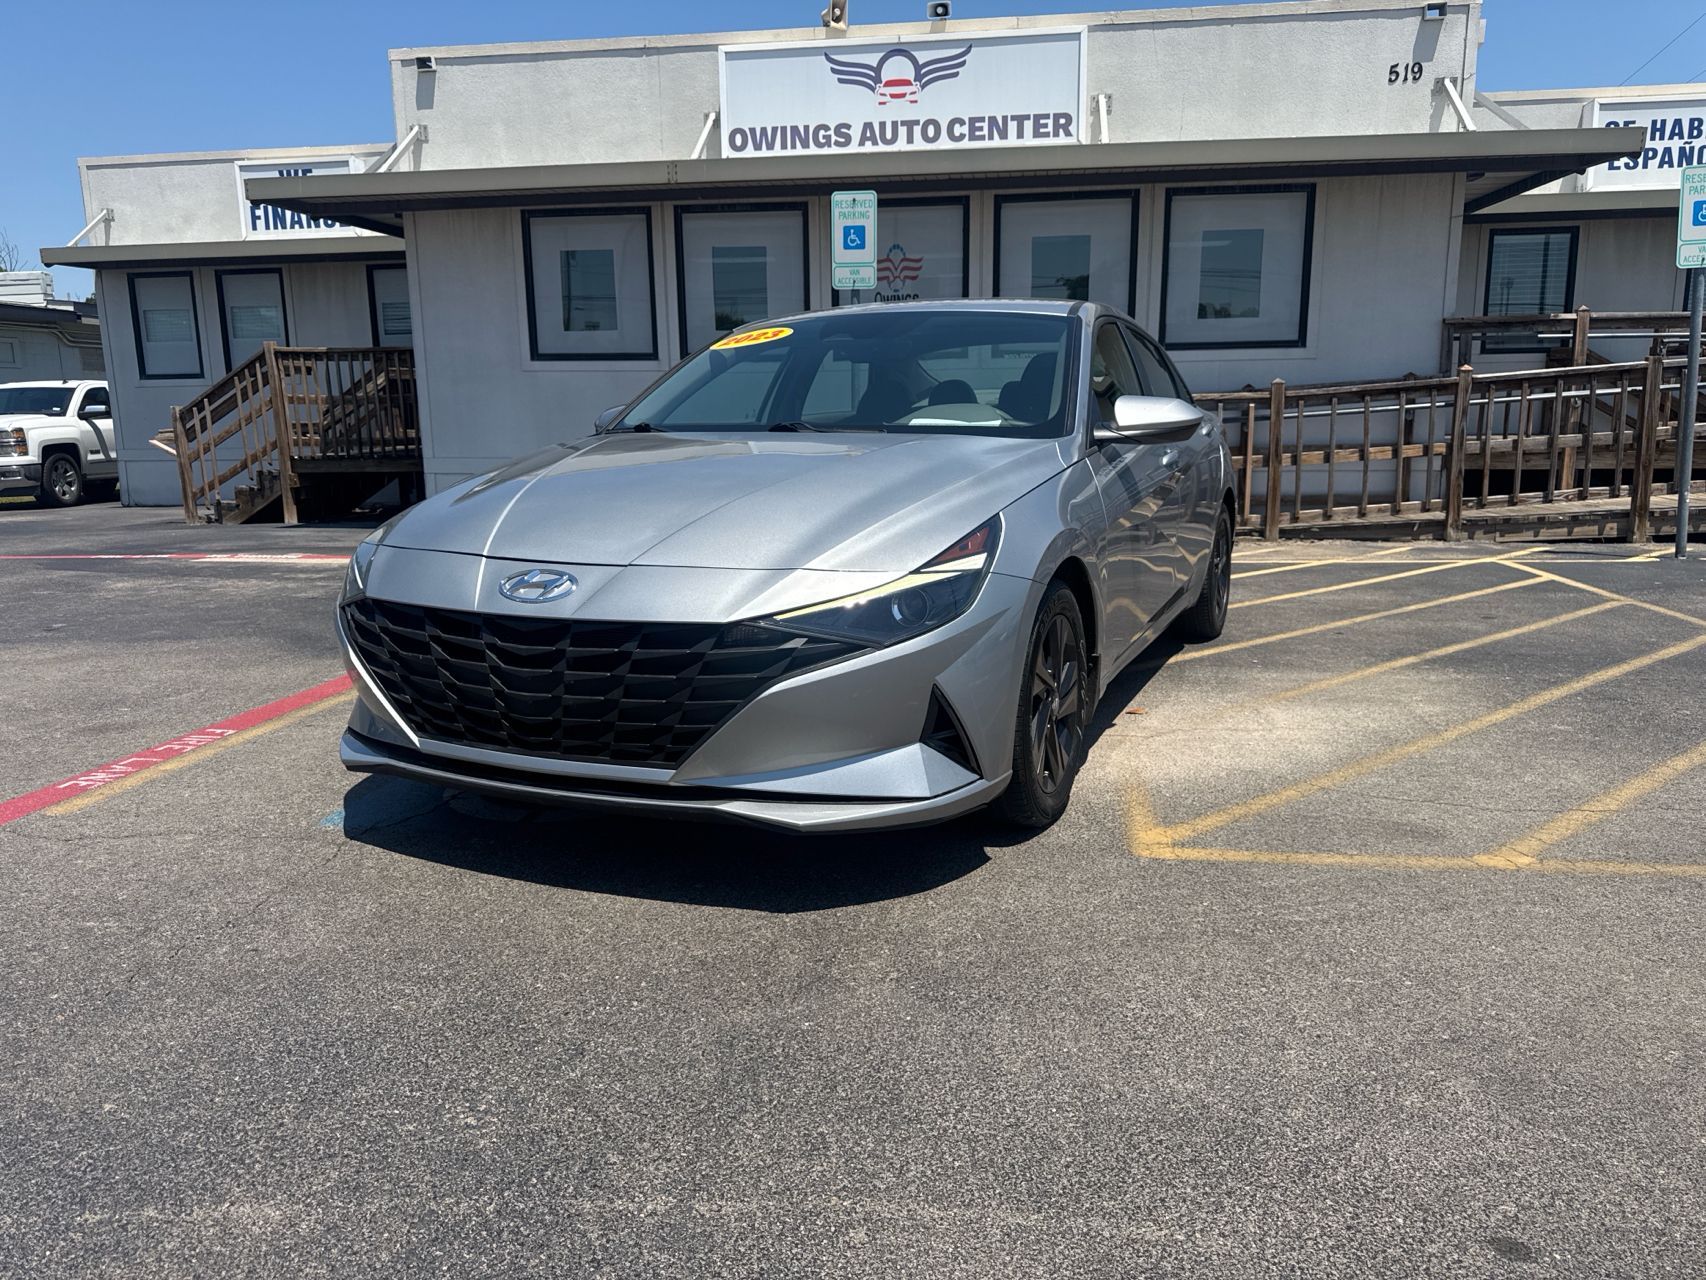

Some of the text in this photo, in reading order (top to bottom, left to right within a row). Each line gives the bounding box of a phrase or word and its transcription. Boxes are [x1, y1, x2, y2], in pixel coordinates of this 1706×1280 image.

[1388, 62, 1423, 83] 519
[728, 112, 1073, 152] OWINGS AUTO CENTER
[835, 199, 873, 209] RESERVED
[838, 210, 870, 220] PARKING
[716, 329, 785, 348] 2023
